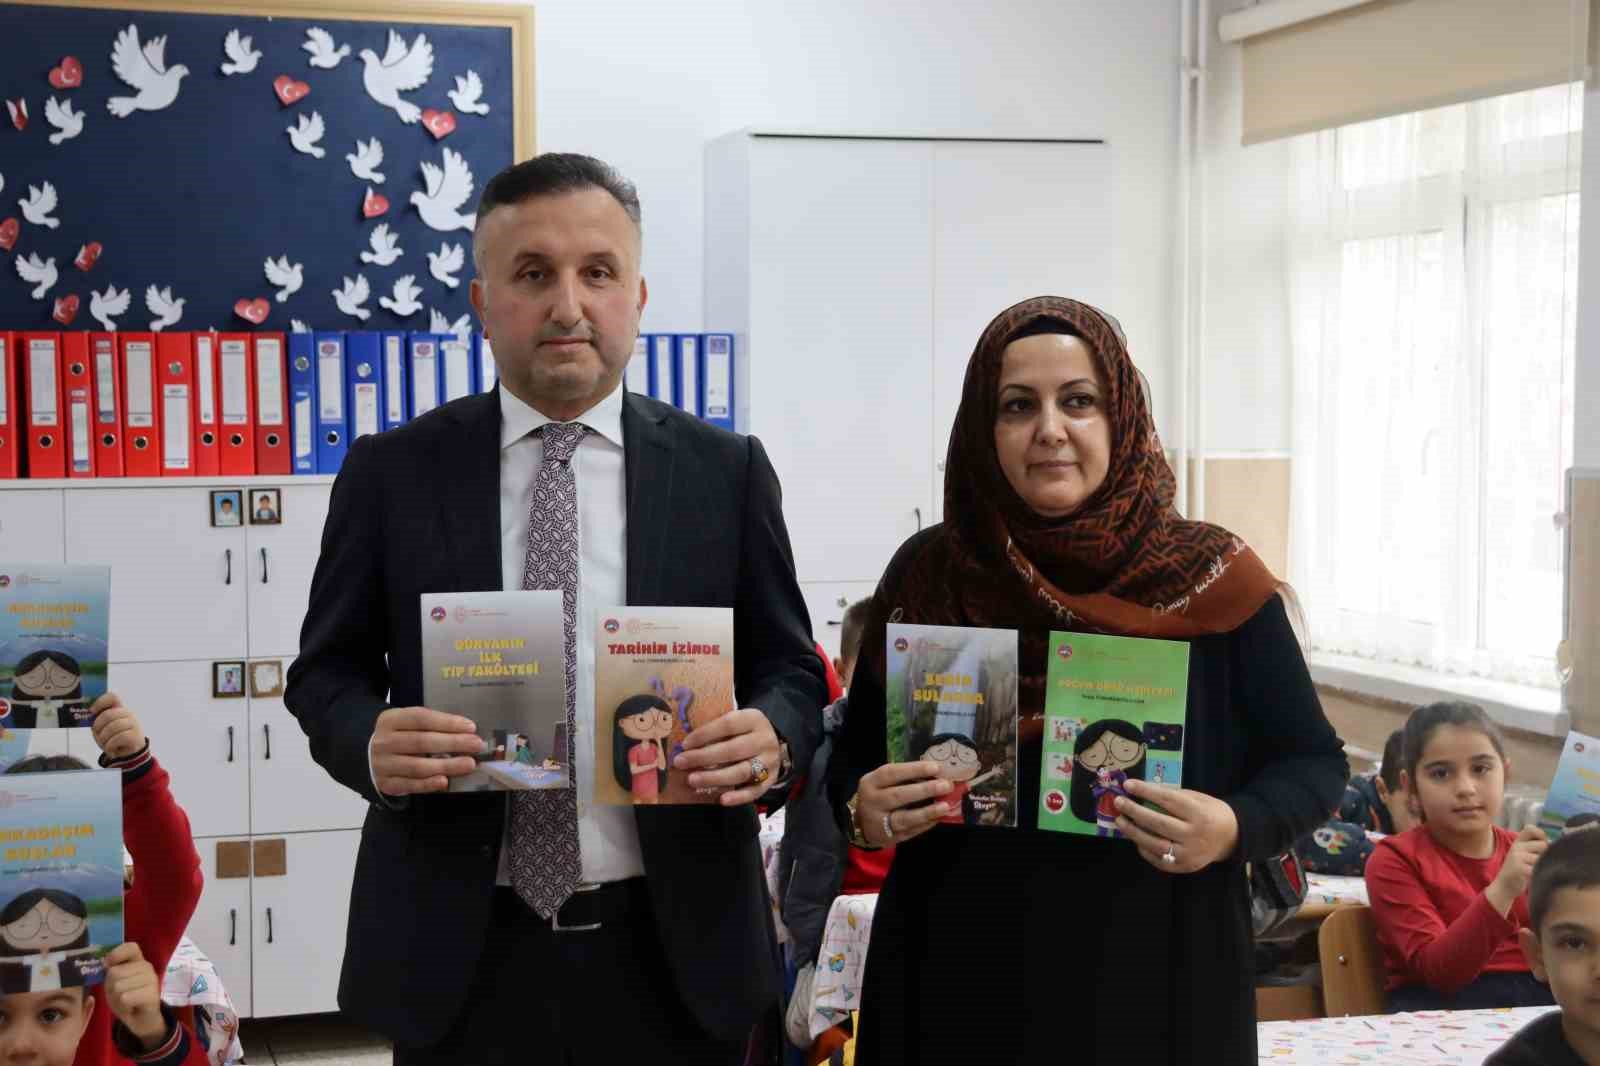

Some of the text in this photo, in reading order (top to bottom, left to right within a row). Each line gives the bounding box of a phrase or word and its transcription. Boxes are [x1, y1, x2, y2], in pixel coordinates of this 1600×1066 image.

[608, 641, 721, 656] TARİHİN İZİNDE
[468, 661, 540, 678] FAKÜLTESİ
